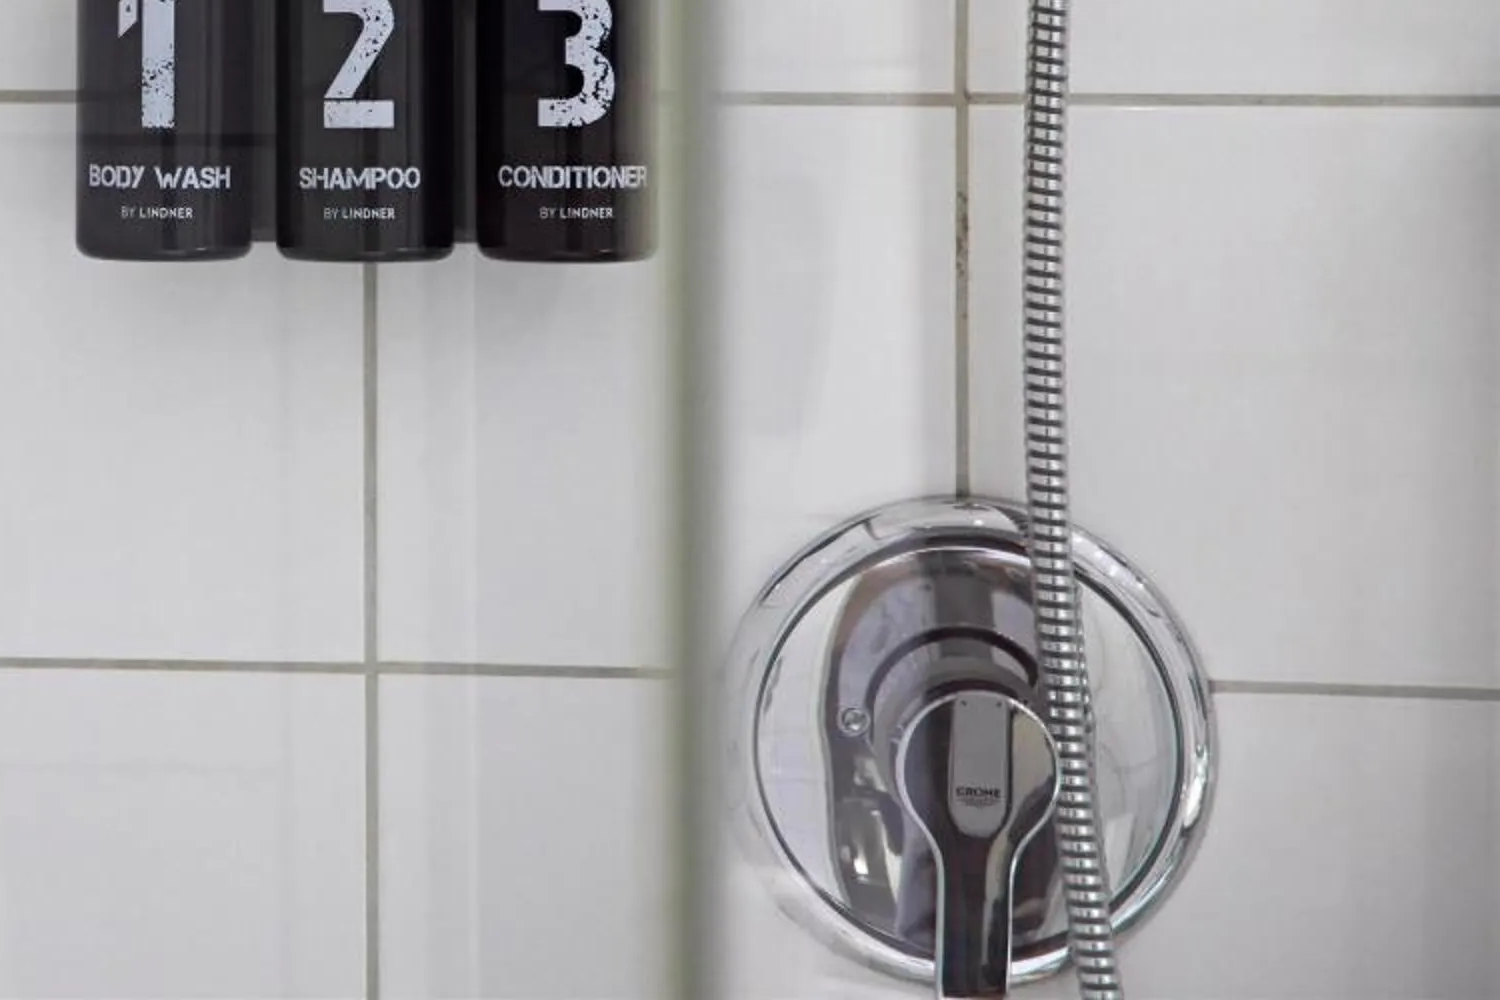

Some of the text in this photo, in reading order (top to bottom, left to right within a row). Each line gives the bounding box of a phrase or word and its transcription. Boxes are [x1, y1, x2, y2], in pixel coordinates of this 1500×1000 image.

[88, 163, 232, 190] BODY WASH
[298, 166, 422, 190] SHAMPOO
[497, 164, 648, 190] CONDITIONER
[120, 206, 194, 220] BY LINDNER
[323, 206, 396, 220] BY LINDNER
[539, 206, 614, 220] BY LINDNER
